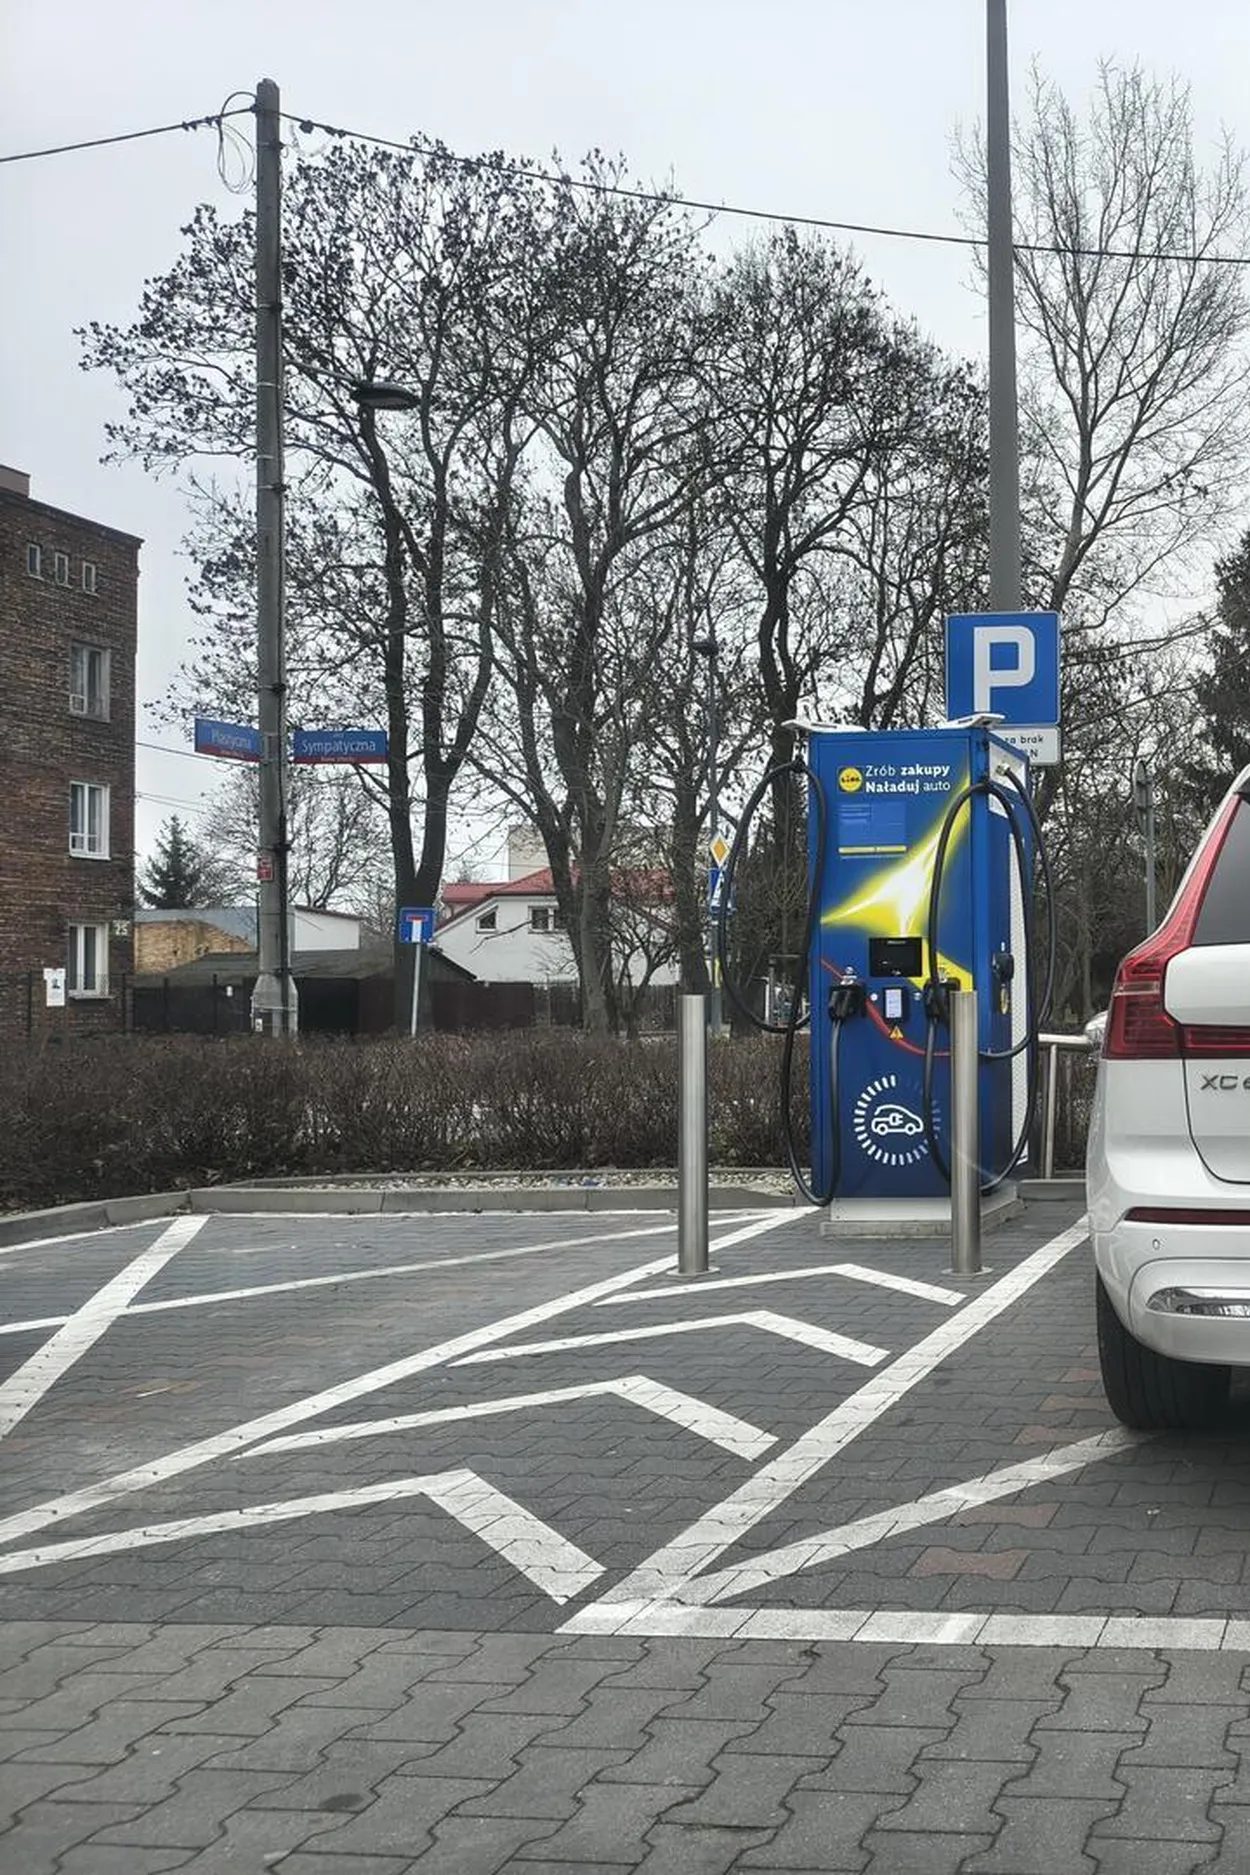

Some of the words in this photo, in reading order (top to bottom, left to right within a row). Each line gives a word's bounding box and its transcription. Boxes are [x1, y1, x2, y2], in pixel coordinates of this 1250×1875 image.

[974, 625, 1035, 712] P
[1021, 735, 1044, 744] brak
[302, 740, 376, 755] Sympatyczna
[866, 765, 896, 777] Zrób
[901, 764, 950, 778] zakupy
[866, 780, 919, 794] Naładuj
[923, 781, 951, 792] auto
